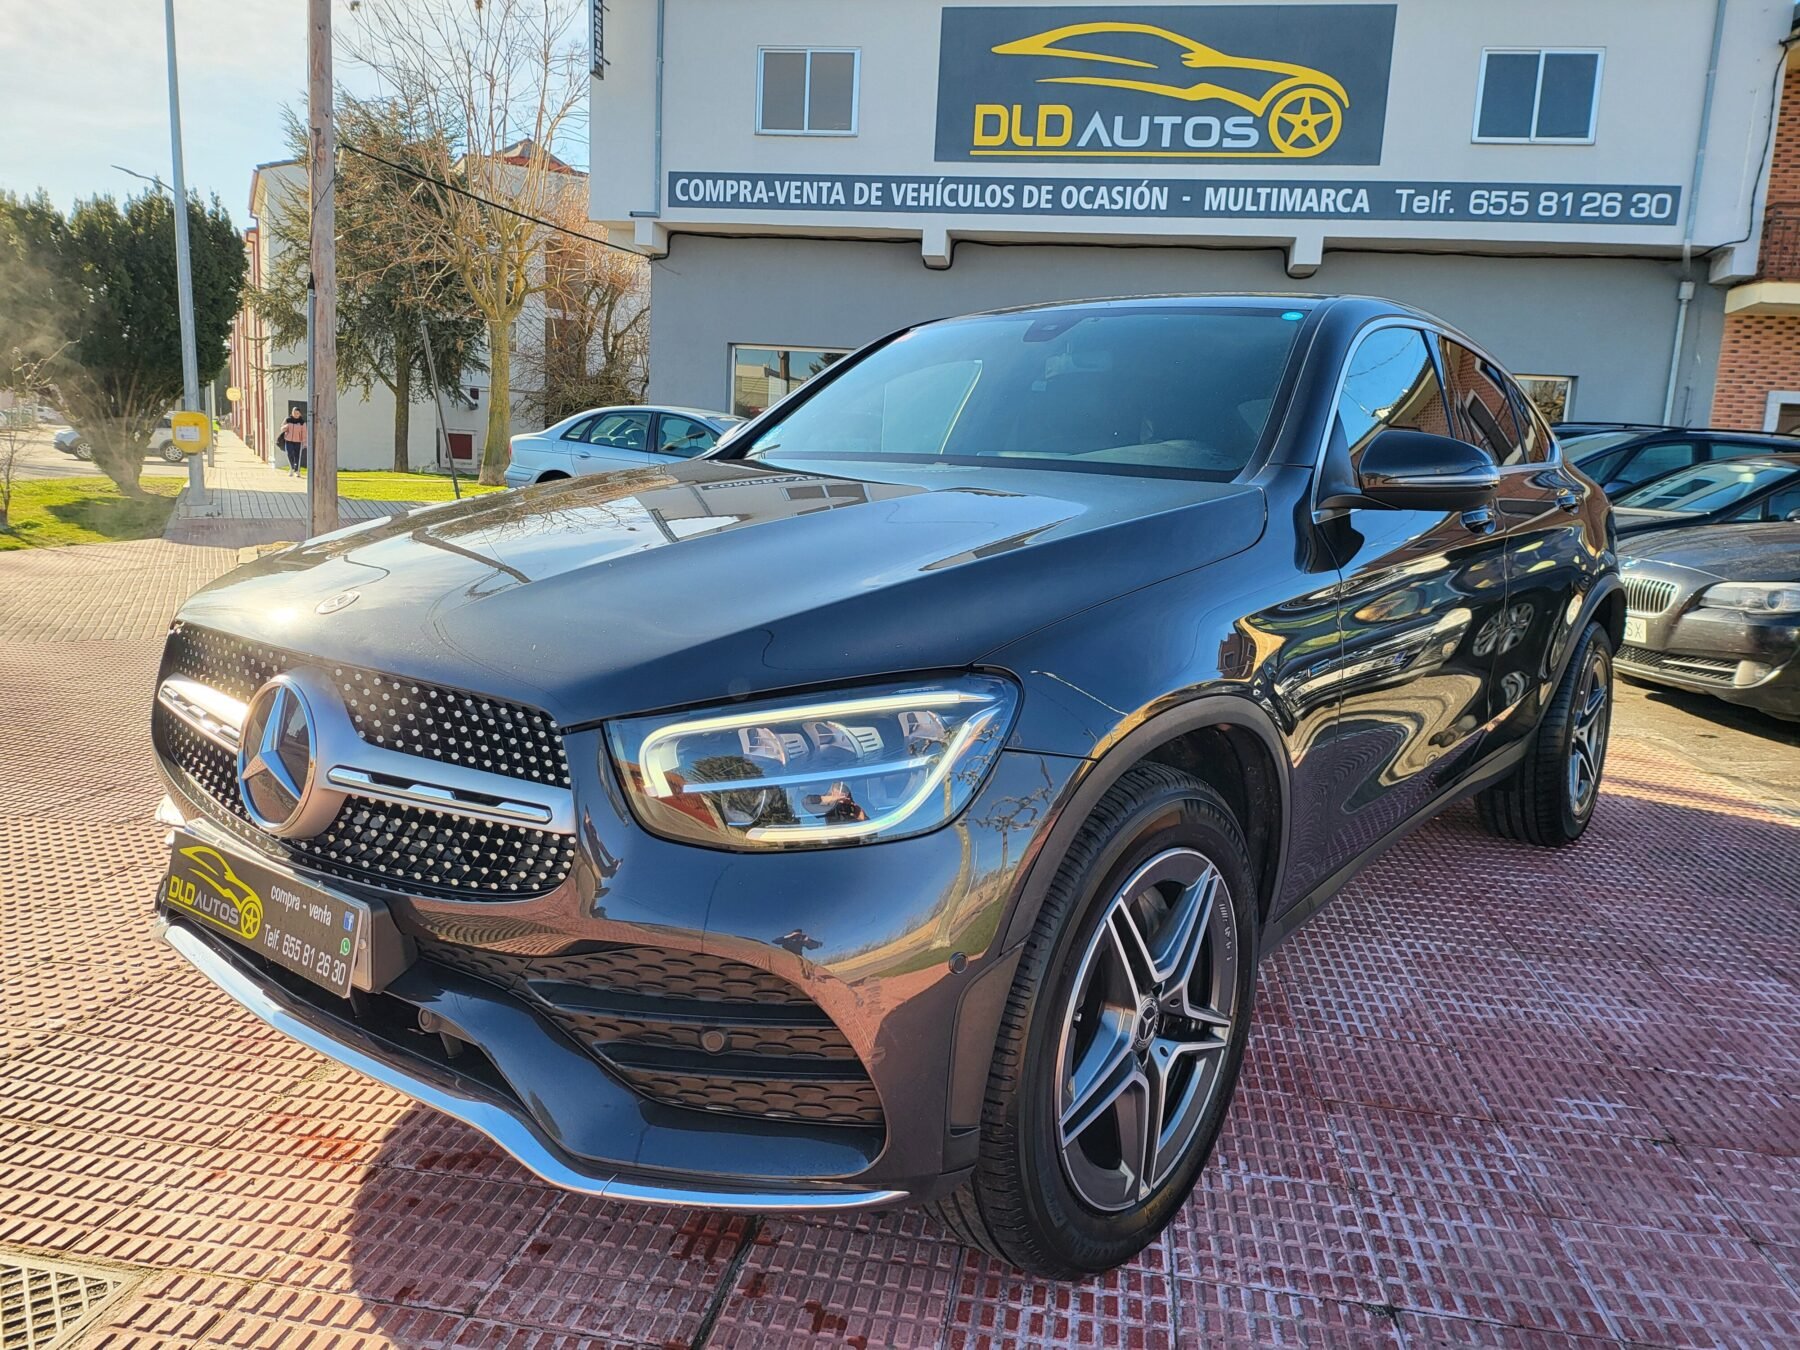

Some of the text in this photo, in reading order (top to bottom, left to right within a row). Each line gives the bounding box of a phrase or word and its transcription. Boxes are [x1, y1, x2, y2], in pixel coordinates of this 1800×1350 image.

[973, 104, 1260, 148] DLD AUTOS
[675, 178, 846, 205] COMPRA-VENTA
[853, 182, 883, 206] DE
[891, 177, 1015, 208] VEHÍCULOS
[1022, 185, 1053, 209] DE
[1061, 180, 1169, 211] OCASIÓN
[1204, 187, 1370, 213] MULTIMARCA
[1395, 189, 1455, 214] Telf.
[1468, 190, 1529, 216] 655
[1537, 191, 1575, 217] 81
[1580, 192, 1623, 218] 26
[1629, 193, 1673, 219] 30
[168, 875, 239, 925] DLD AUTOS
[270, 885, 301, 912] compra
[309, 903, 332, 926] venta
[263, 923, 346, 985] Telf. 655 81 26 30
